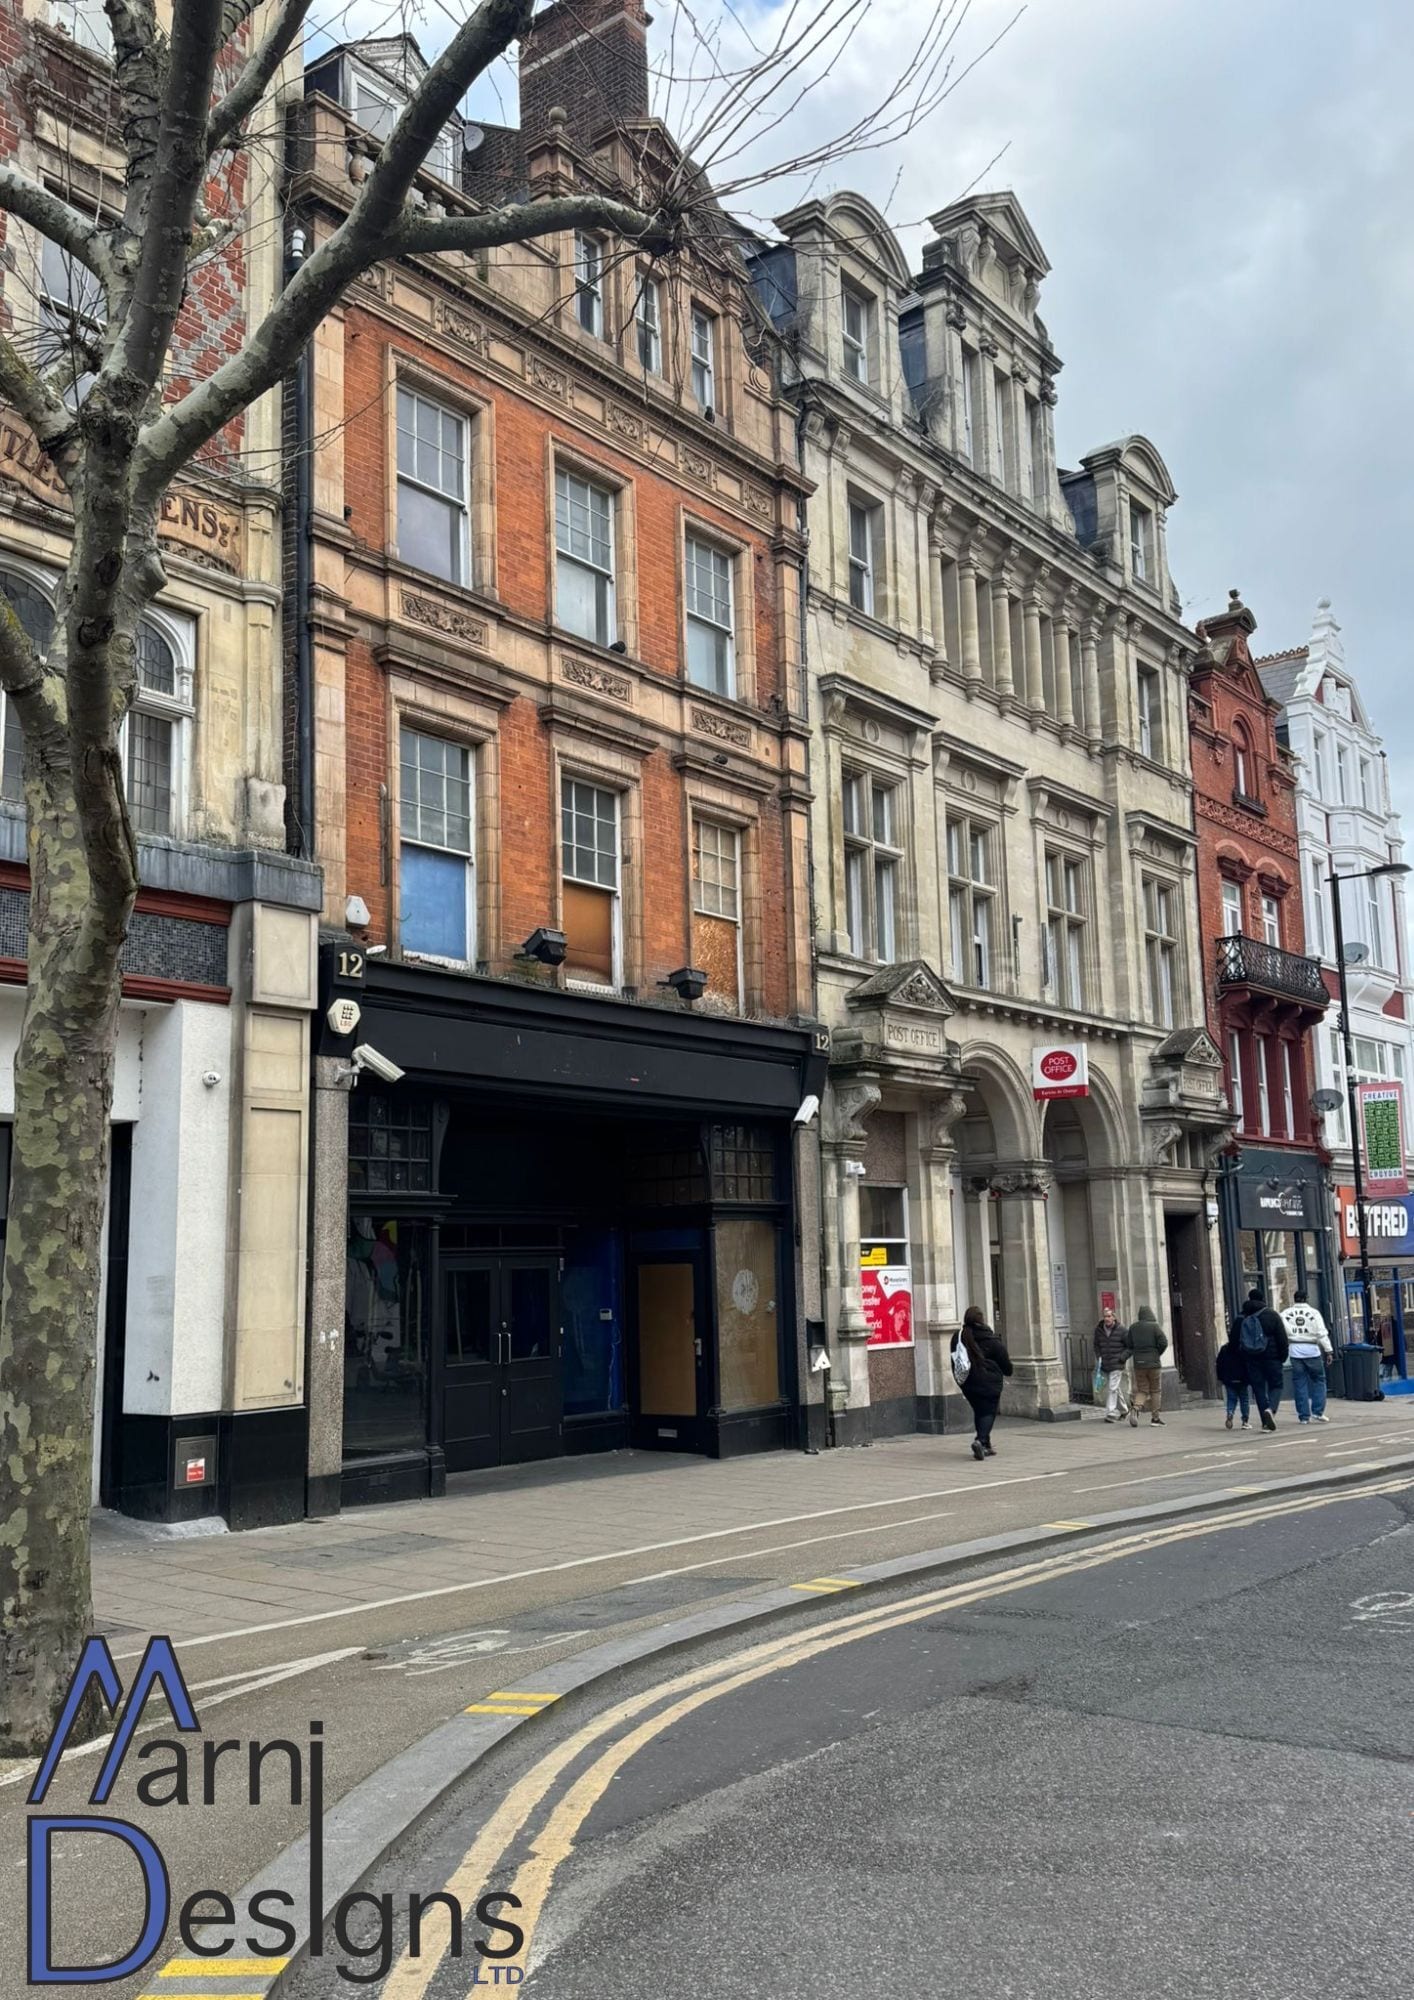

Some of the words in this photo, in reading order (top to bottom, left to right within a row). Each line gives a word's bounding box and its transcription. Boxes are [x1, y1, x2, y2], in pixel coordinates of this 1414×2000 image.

[338, 952, 363, 977] 12
[888, 1024, 909, 1043] POST
[911, 1029, 939, 1048] OFFICE
[815, 1033, 829, 1051] 12
[1049, 1056, 1069, 1066] POST
[1044, 1065, 1073, 1074] OFFICE
[1363, 1091, 1398, 1100] CREATIVE
[1369, 1170, 1403, 1178] CROYDON
[861, 1285, 878, 1297] oney
